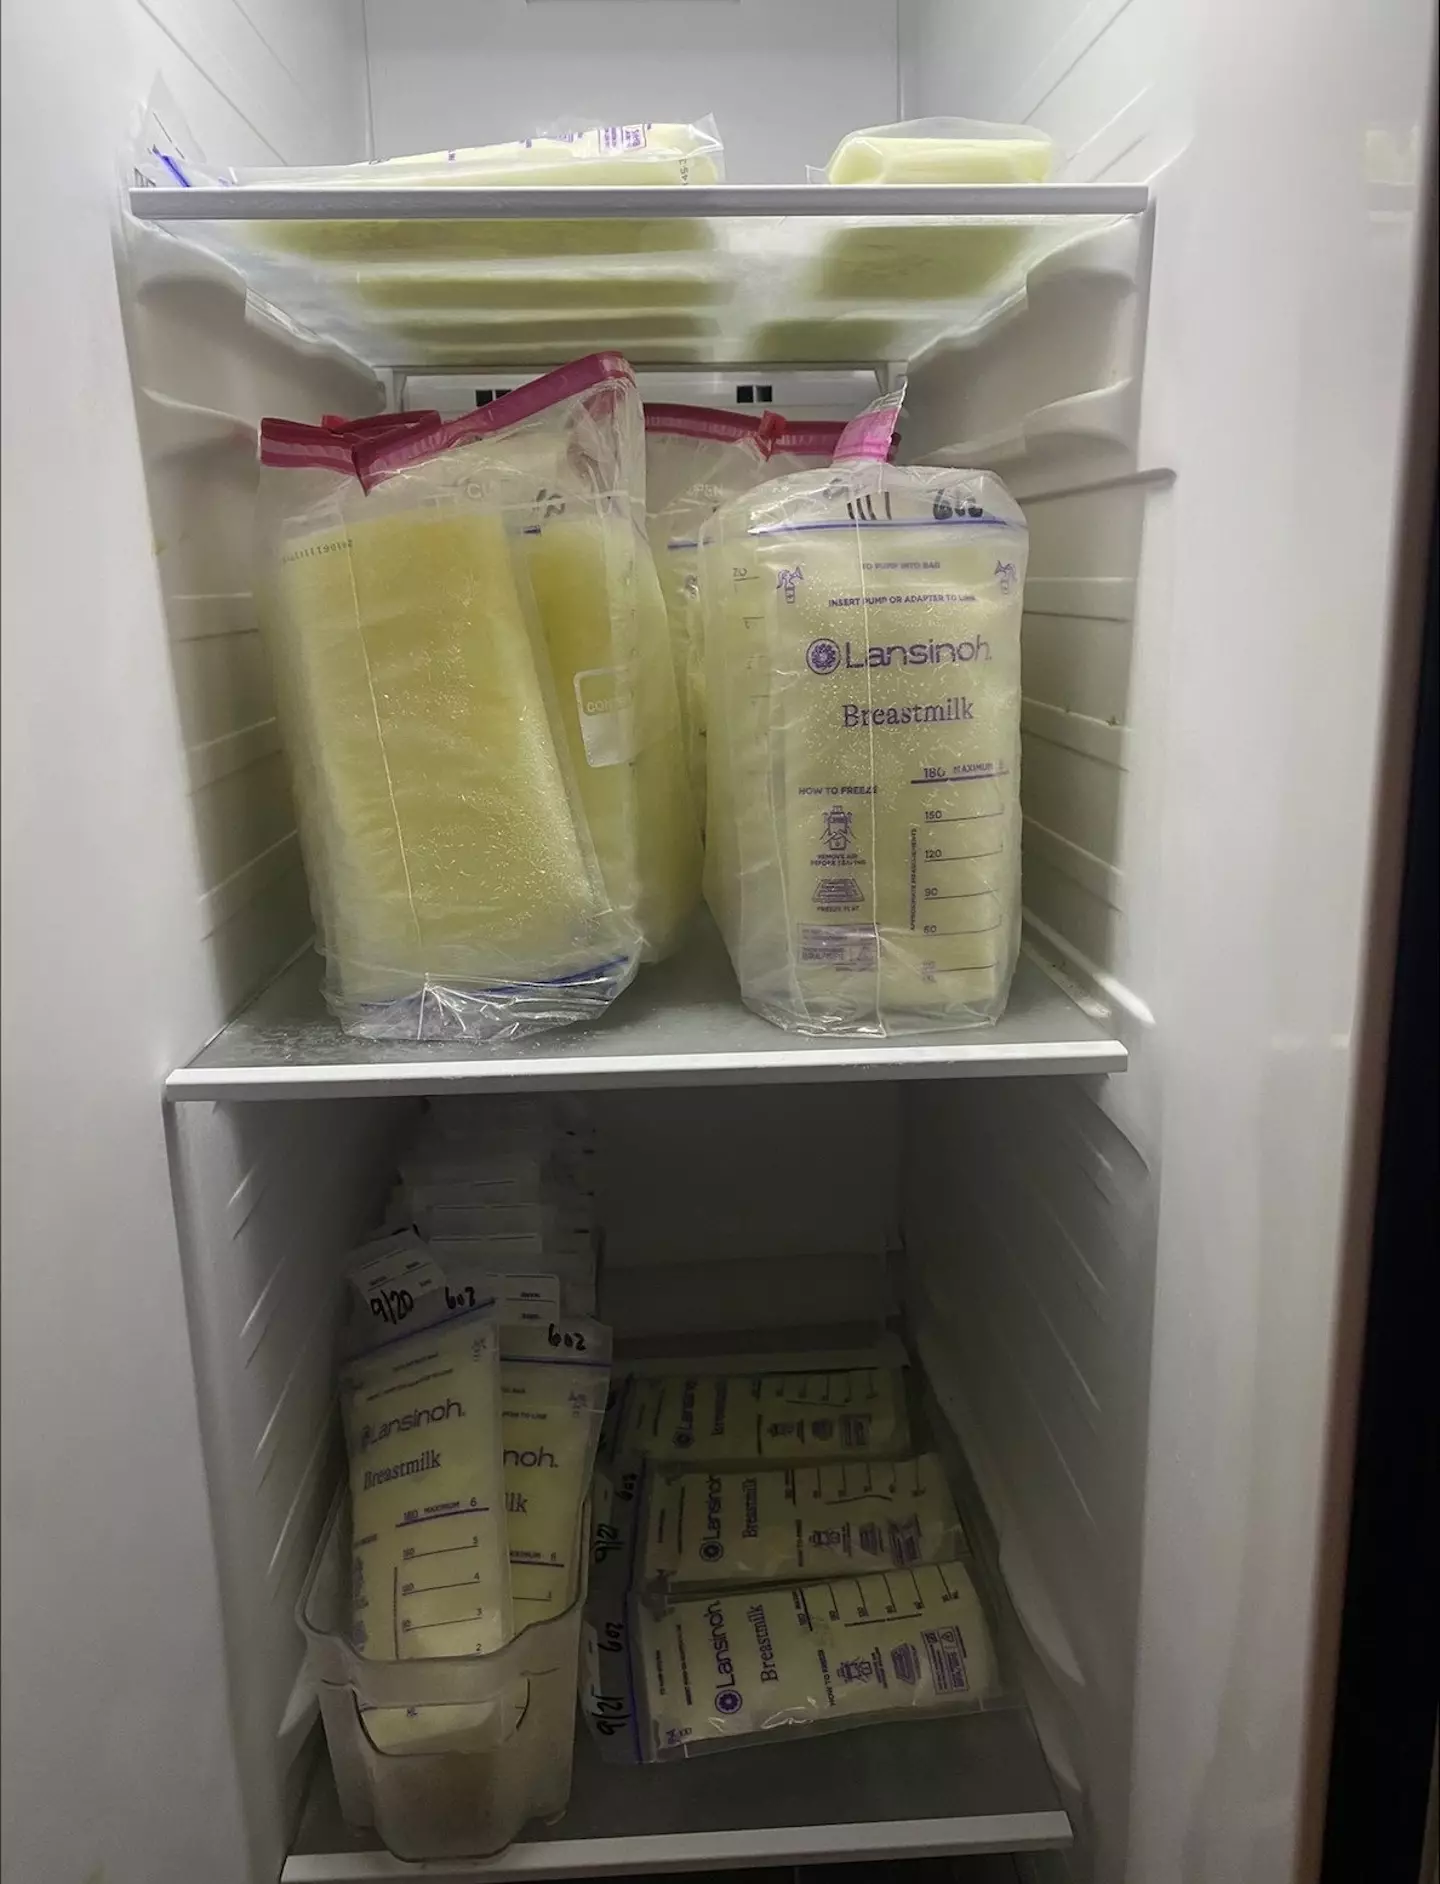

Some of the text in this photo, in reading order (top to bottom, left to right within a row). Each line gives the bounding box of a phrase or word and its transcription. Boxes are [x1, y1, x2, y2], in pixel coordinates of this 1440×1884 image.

[828, 598, 861, 607] INSERT
[889, 595, 903, 604] OR
[904, 594, 945, 604] ADAPTER
[842, 696, 975, 728] Breastmilk
[922, 767, 946, 779] 180
[798, 786, 825, 796] HOW
[825, 786, 839, 796] TO
[924, 810, 943, 820] 150
[924, 849, 943, 859] 120
[924, 887, 939, 897] 90
[370, 1288, 414, 1325] 9/20
[363, 1449, 442, 1491] Breastmilk
[470, 1497, 477, 1507] 6
[473, 1572, 480, 1581] 4
[476, 1607, 483, 1617] 3
[475, 1643, 482, 1652] 2
[704, 1599, 736, 1688] Lansinoh
[746, 1603, 778, 1684] Breastmilk
